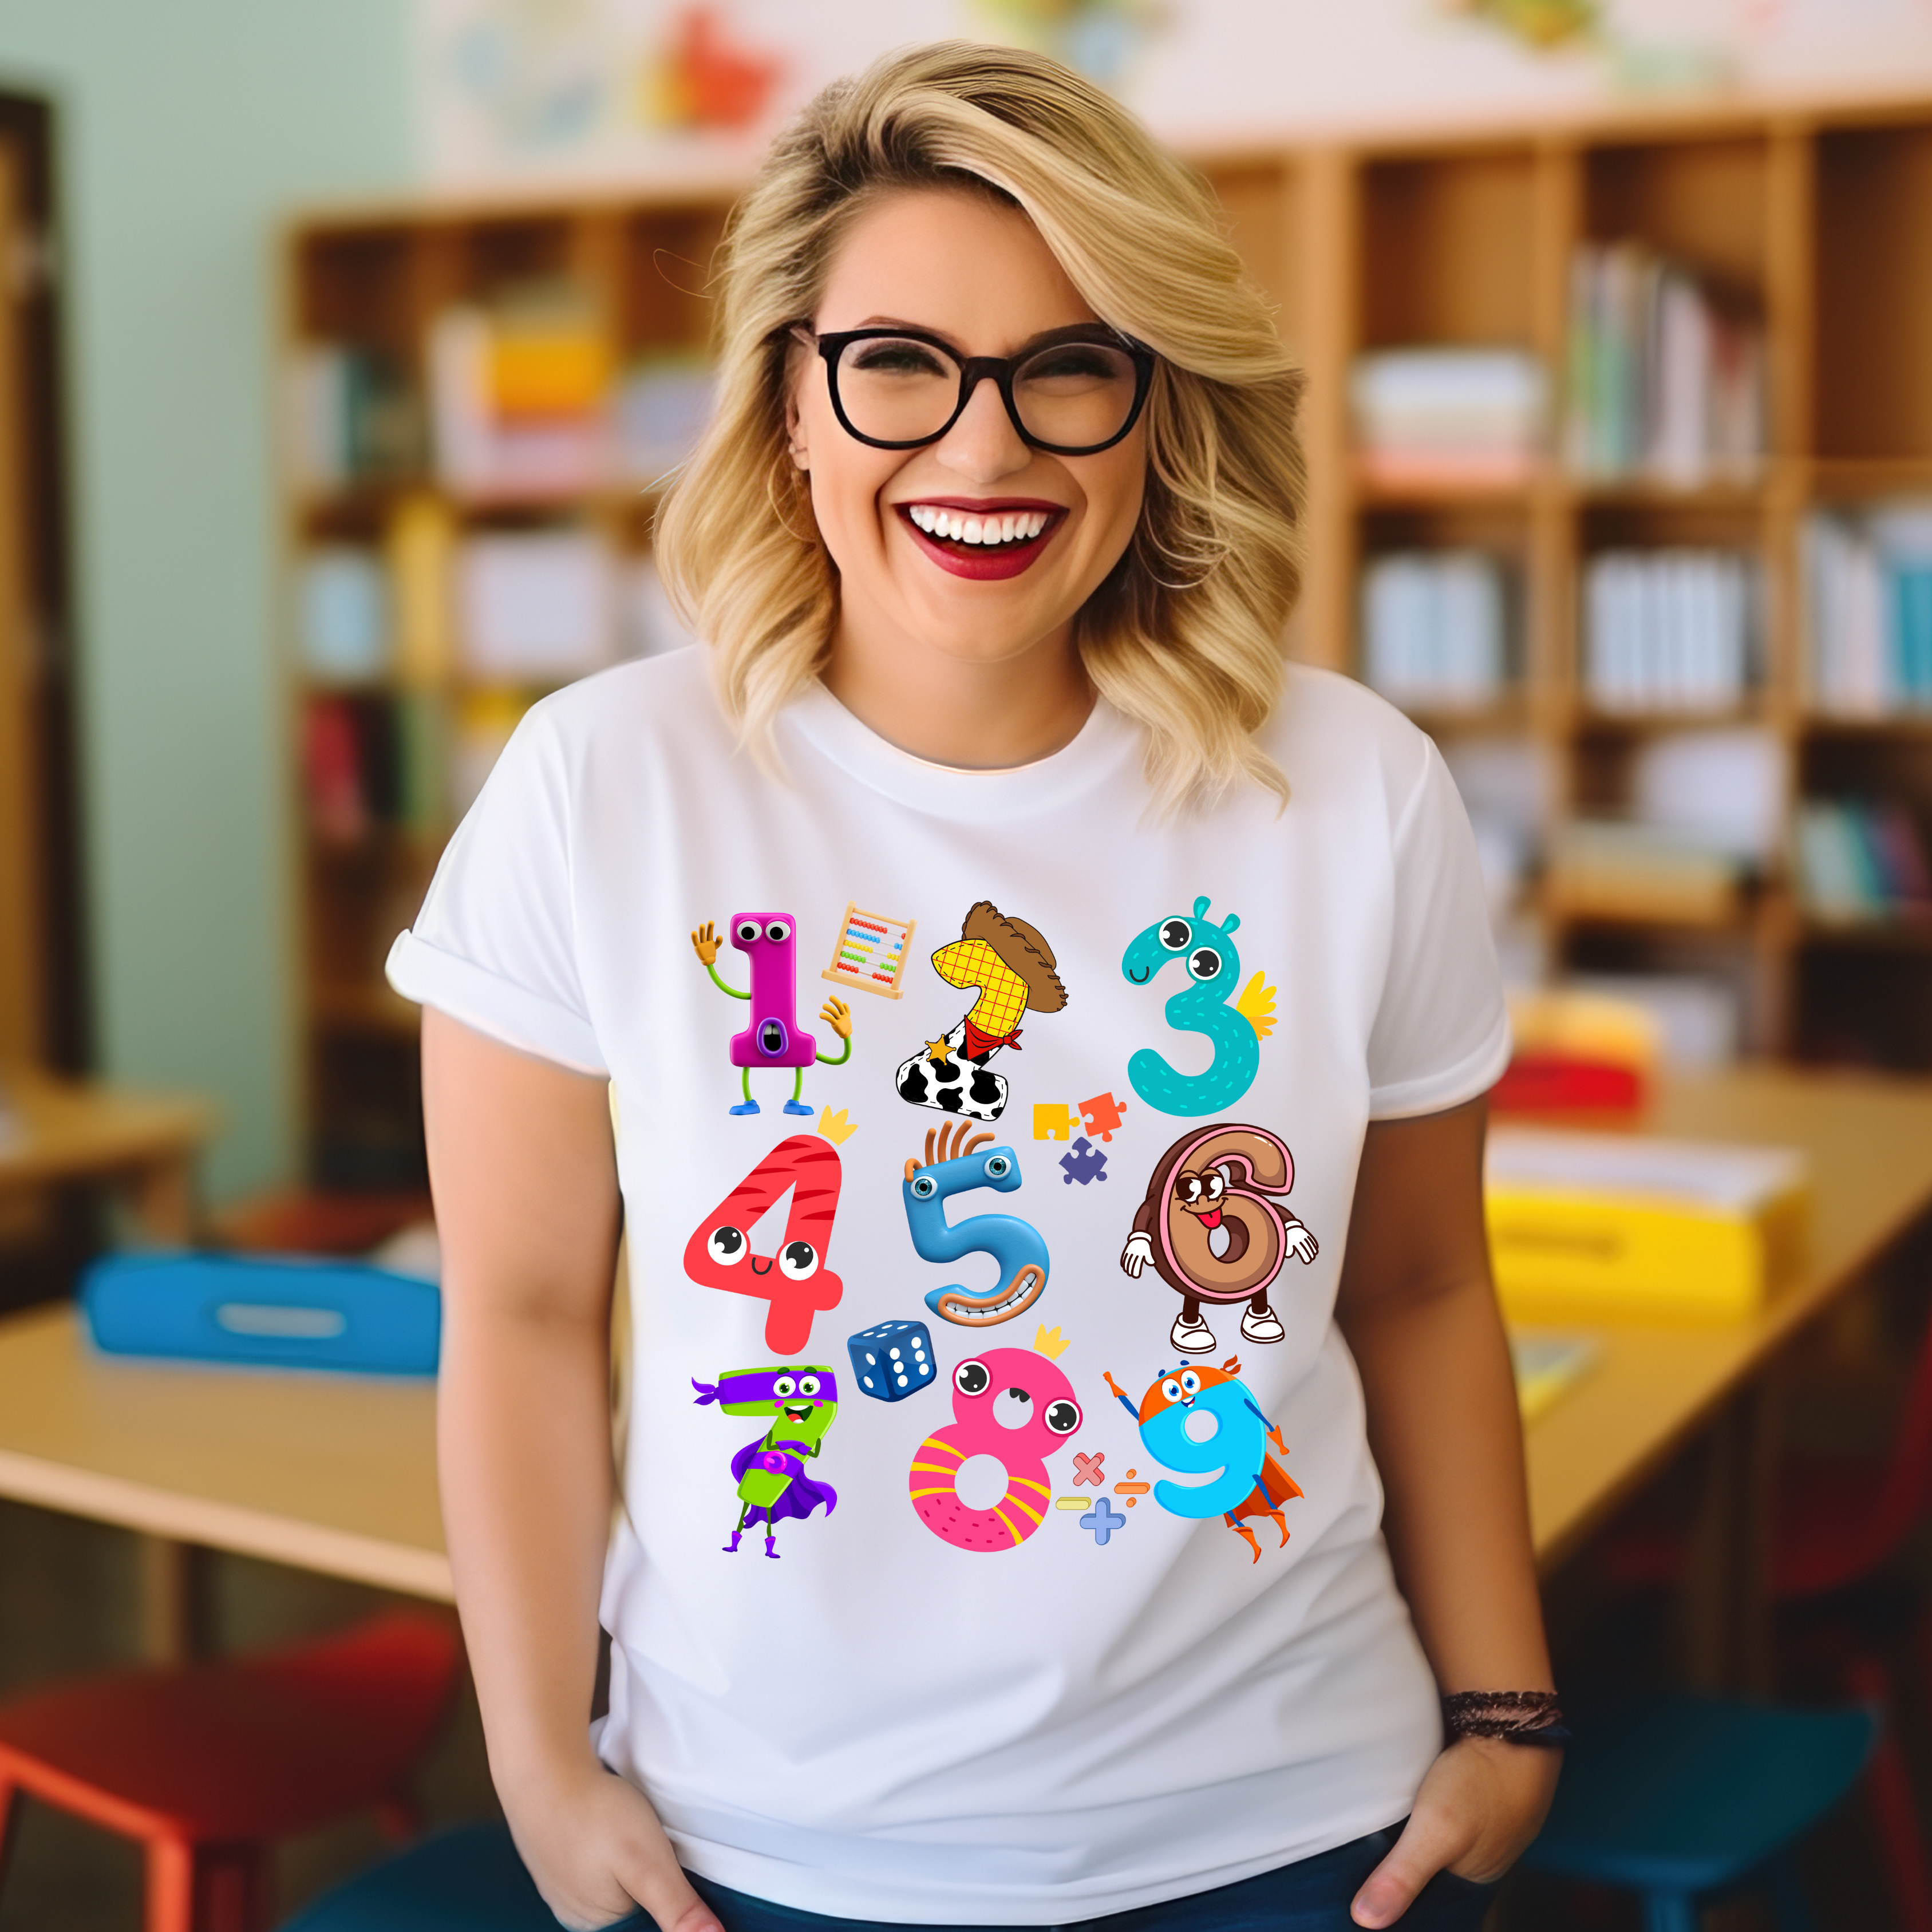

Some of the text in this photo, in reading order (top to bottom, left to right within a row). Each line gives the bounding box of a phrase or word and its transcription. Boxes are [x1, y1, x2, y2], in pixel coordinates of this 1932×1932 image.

[729, 913, 1259, 1121] 1 2 3
[683, 1124, 1294, 1355] 4 5 6
[718, 1348, 1265, 1552] 7 8 9
